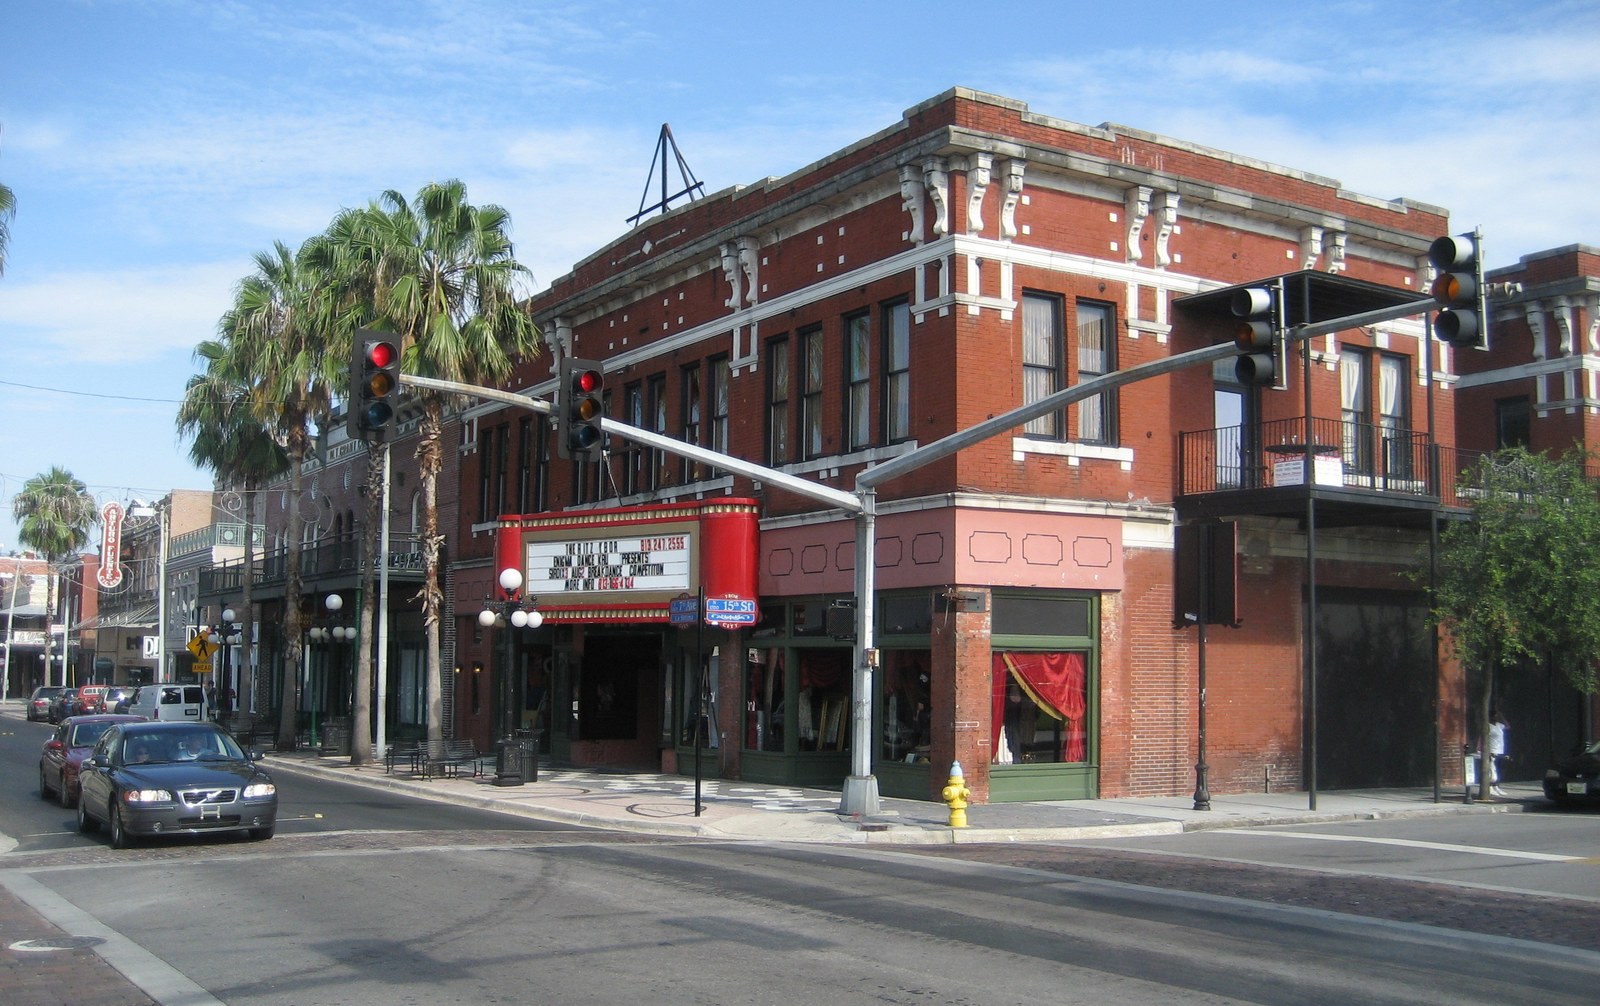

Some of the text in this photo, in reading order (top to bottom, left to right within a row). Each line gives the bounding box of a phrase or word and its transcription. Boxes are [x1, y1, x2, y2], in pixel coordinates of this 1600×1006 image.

[107, 508, 117, 544] ARTURO
[565, 537, 684, 556] THE RITZ YBOR 813.247.2555
[105, 545, 115, 580] FUENTE
[553, 556, 572, 568] ENIGMA
[577, 554, 595, 567] DANCE
[597, 553, 609, 566] KRU
[564, 579, 580, 591] MORE
[582, 578, 595, 591] INFO
[724, 600, 753, 612] 15th St
